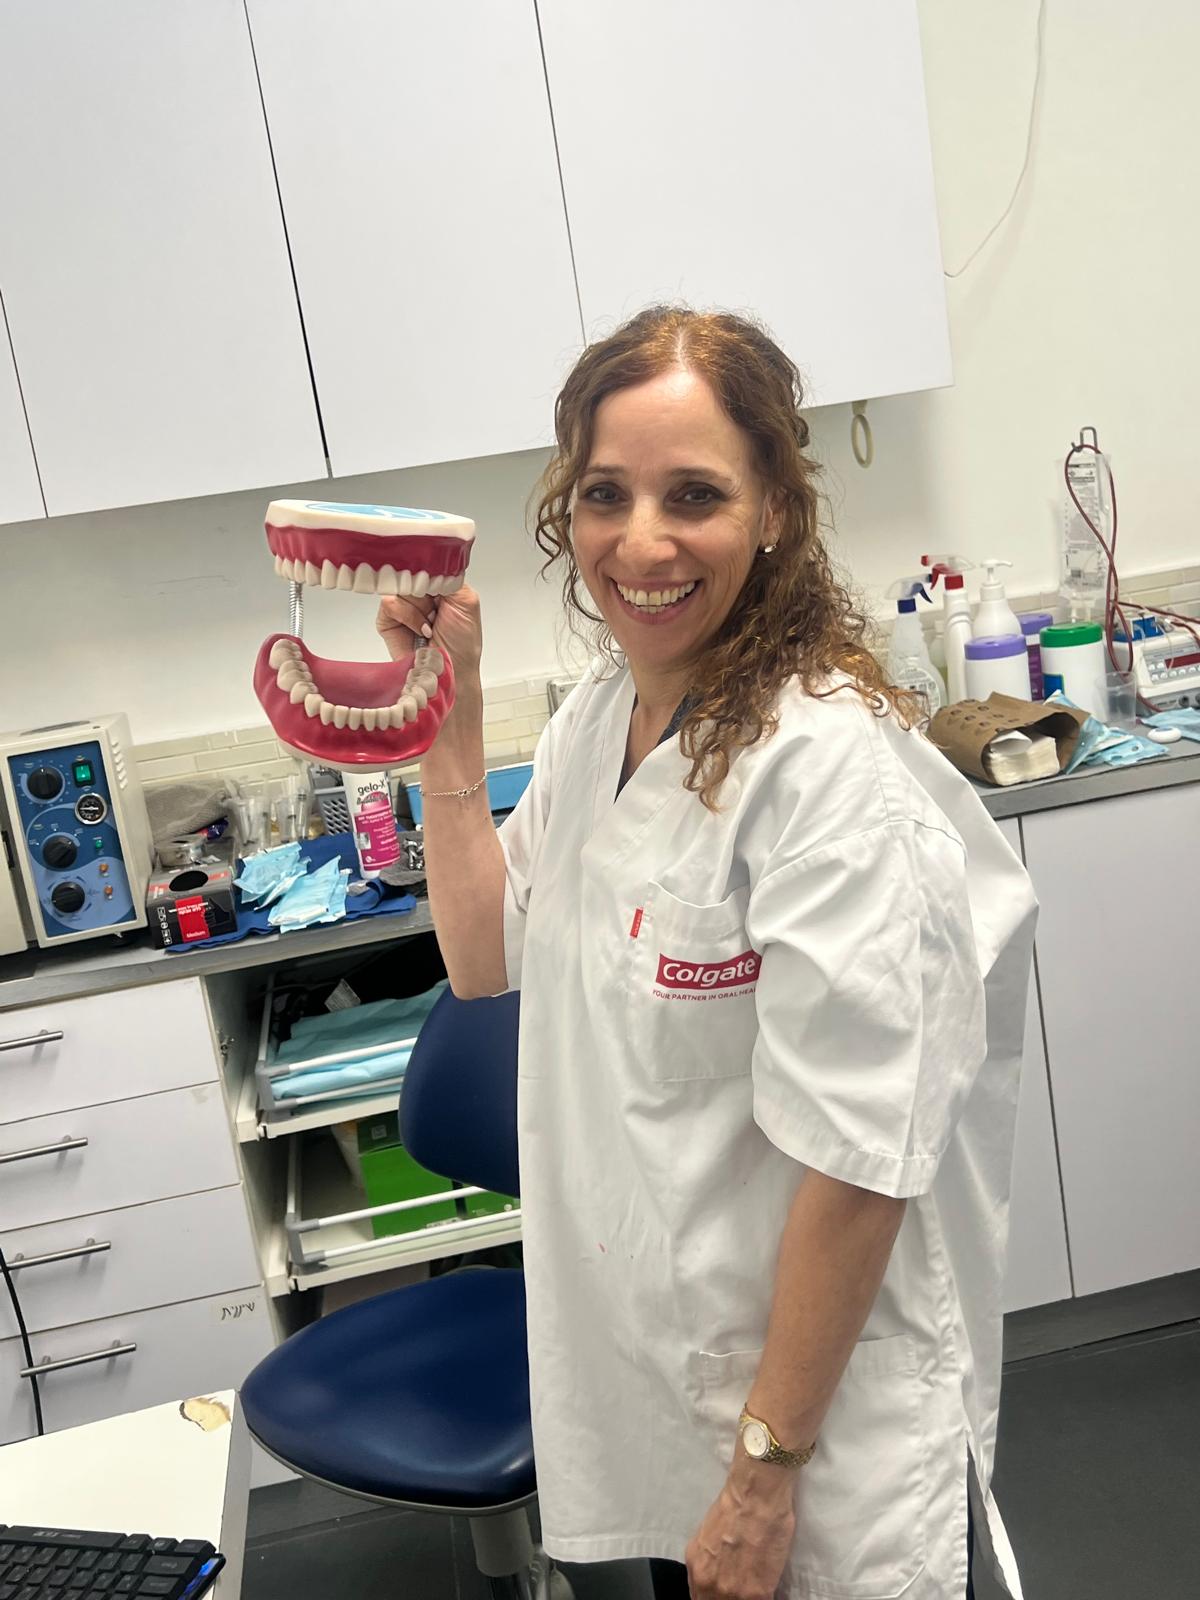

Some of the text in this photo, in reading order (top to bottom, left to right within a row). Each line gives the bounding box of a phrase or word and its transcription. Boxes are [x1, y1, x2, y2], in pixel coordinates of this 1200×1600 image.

[663, 958, 756, 987] Colgate
[652, 989, 671, 1000] YOUR
[671, 993, 707, 1001] PARTNER
[717, 991, 739, 1000] ORAL
